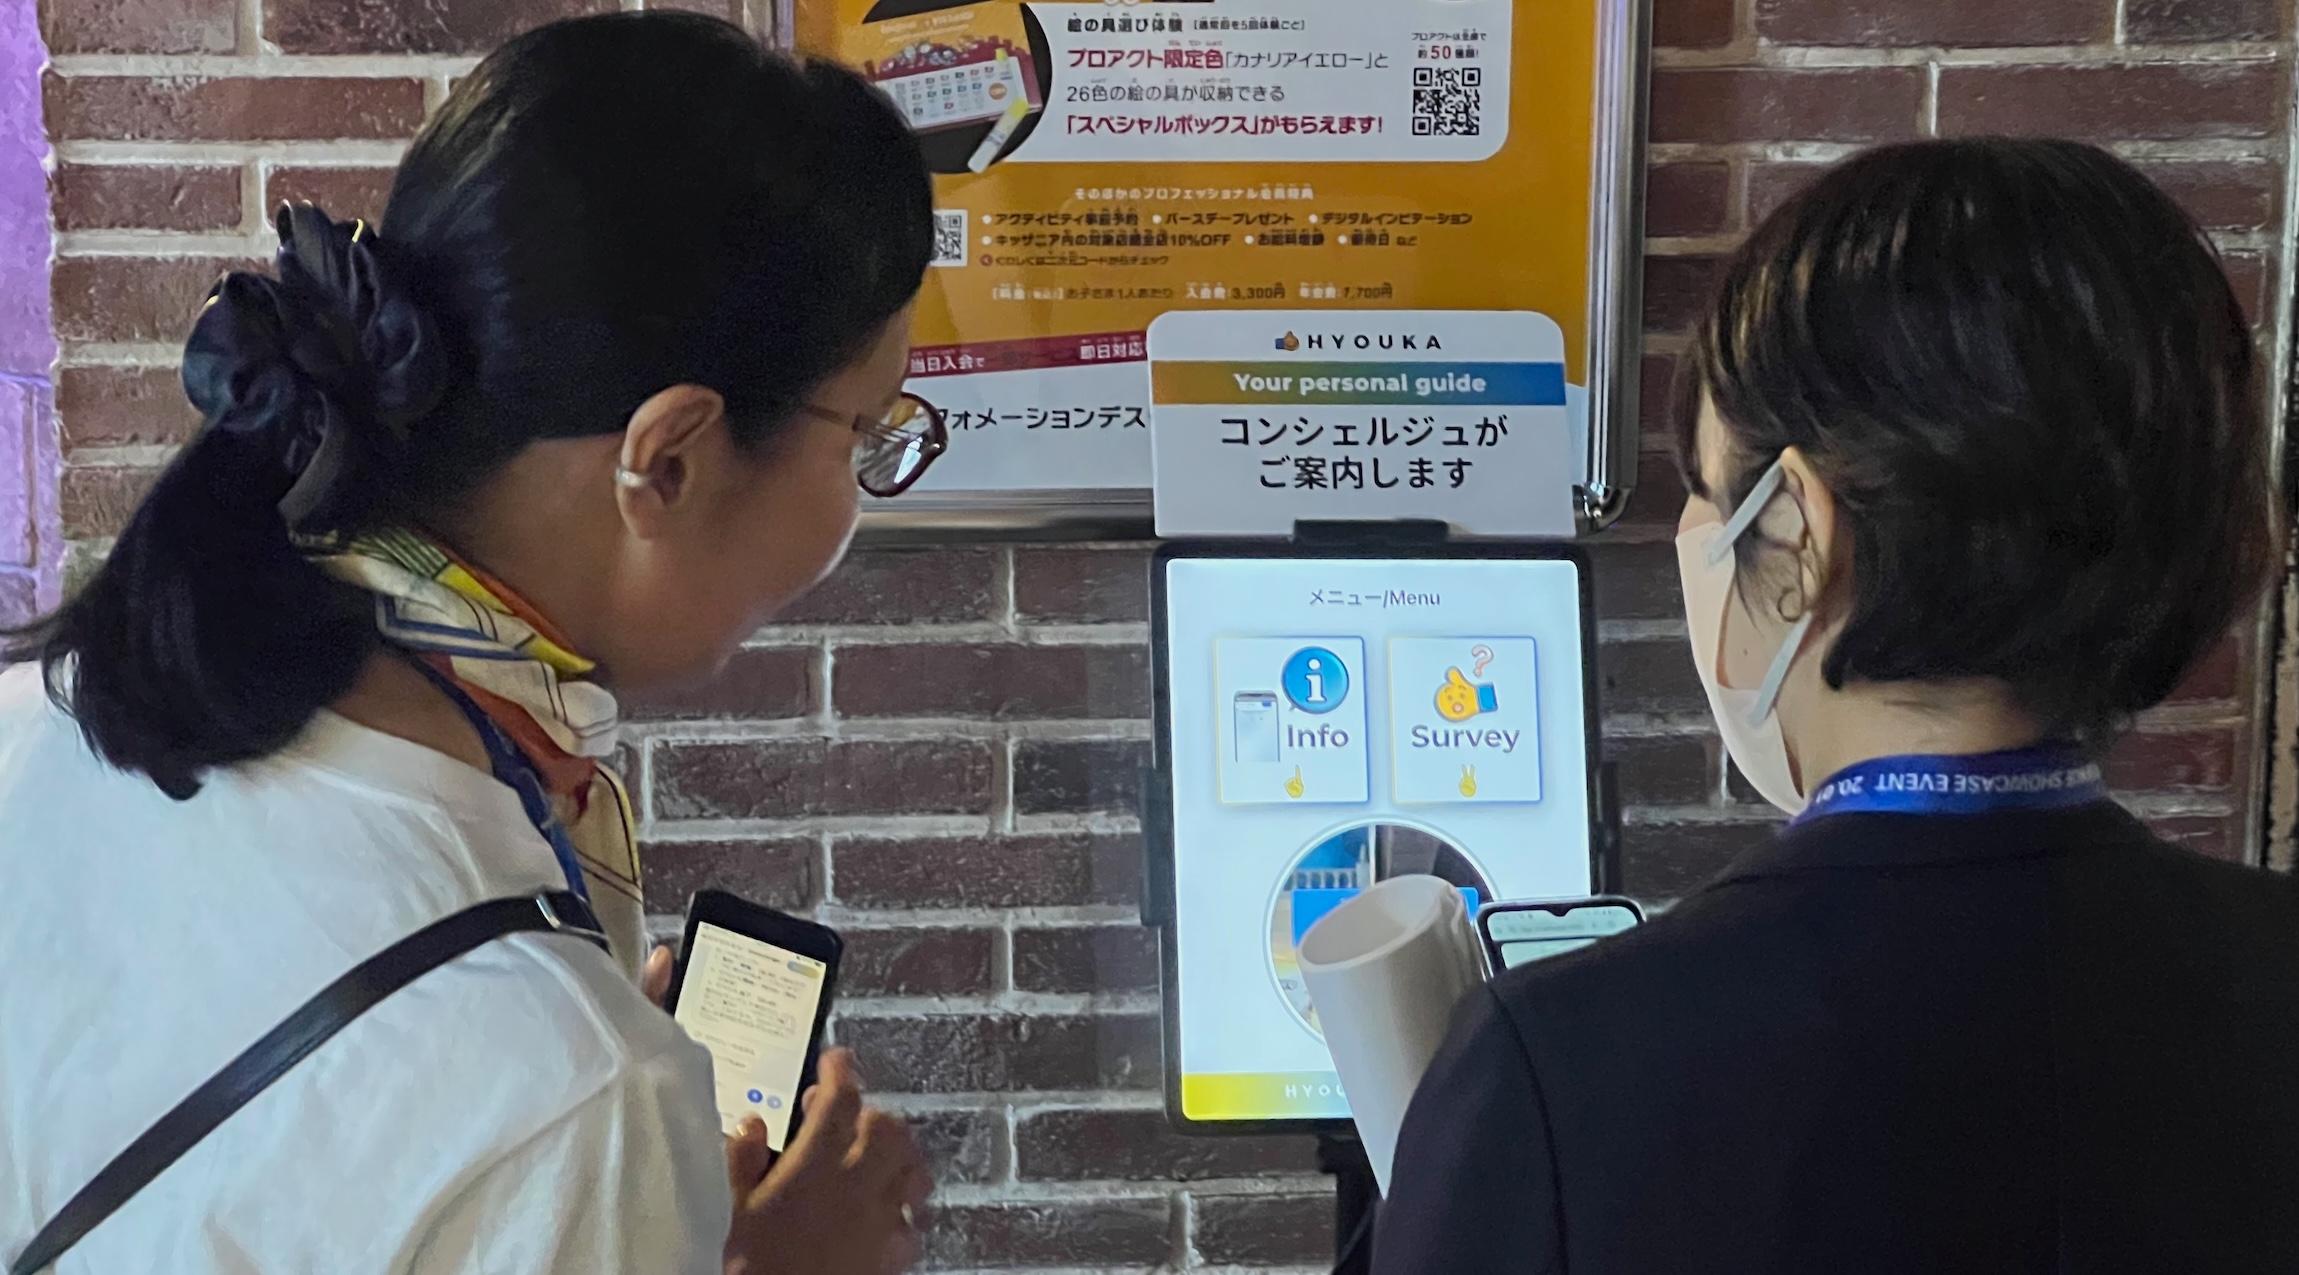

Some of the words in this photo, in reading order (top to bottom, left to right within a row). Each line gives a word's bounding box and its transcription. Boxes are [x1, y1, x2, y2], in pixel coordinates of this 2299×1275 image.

[1067, 18, 1183, 33] 絵の具選び体験
[1067, 48, 1389, 69] プロアクト限定色「カナリアイエロー」と
[1067, 84, 1285, 101] 26色の絵の具が収納できる
[1067, 114, 1383, 135] 「スペシャルボックス」がもらえます!
[1308, 334, 1442, 350] HYOUKA
[1233, 373, 1291, 391] Your
[1300, 372, 1408, 395] personal
[1415, 372, 1487, 396] guide
[1220, 414, 1508, 447] コンシェルジュが
[1259, 455, 1473, 490] ご案内します
[1309, 588, 1441, 608] メニュー/Menu
[1287, 723, 1349, 748] Info
[1411, 725, 1520, 753] Survey
[1875, 772, 1949, 792] EVENT
